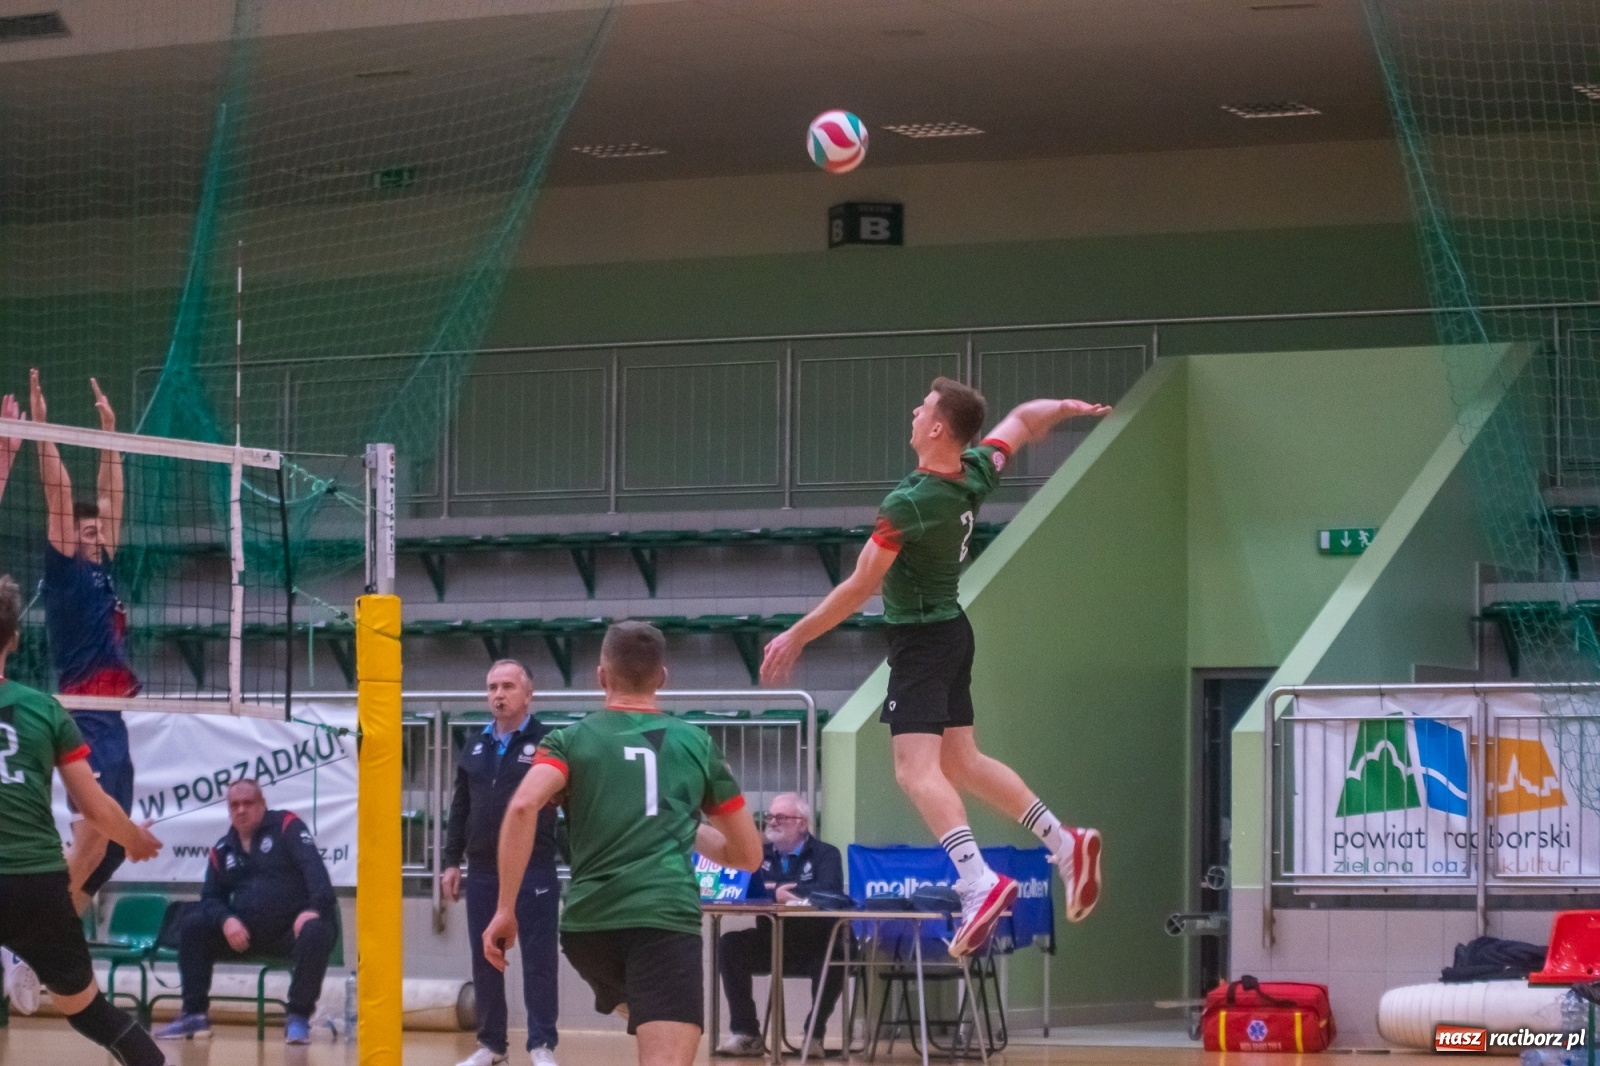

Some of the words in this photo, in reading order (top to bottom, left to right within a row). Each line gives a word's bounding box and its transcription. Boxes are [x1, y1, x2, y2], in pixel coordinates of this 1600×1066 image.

[860, 216, 891, 240] B
[624, 746, 658, 817] 7
[138, 790, 165, 819] W
[1333, 823, 1426, 856] powiat
[1333, 856, 1414, 873] zielona
